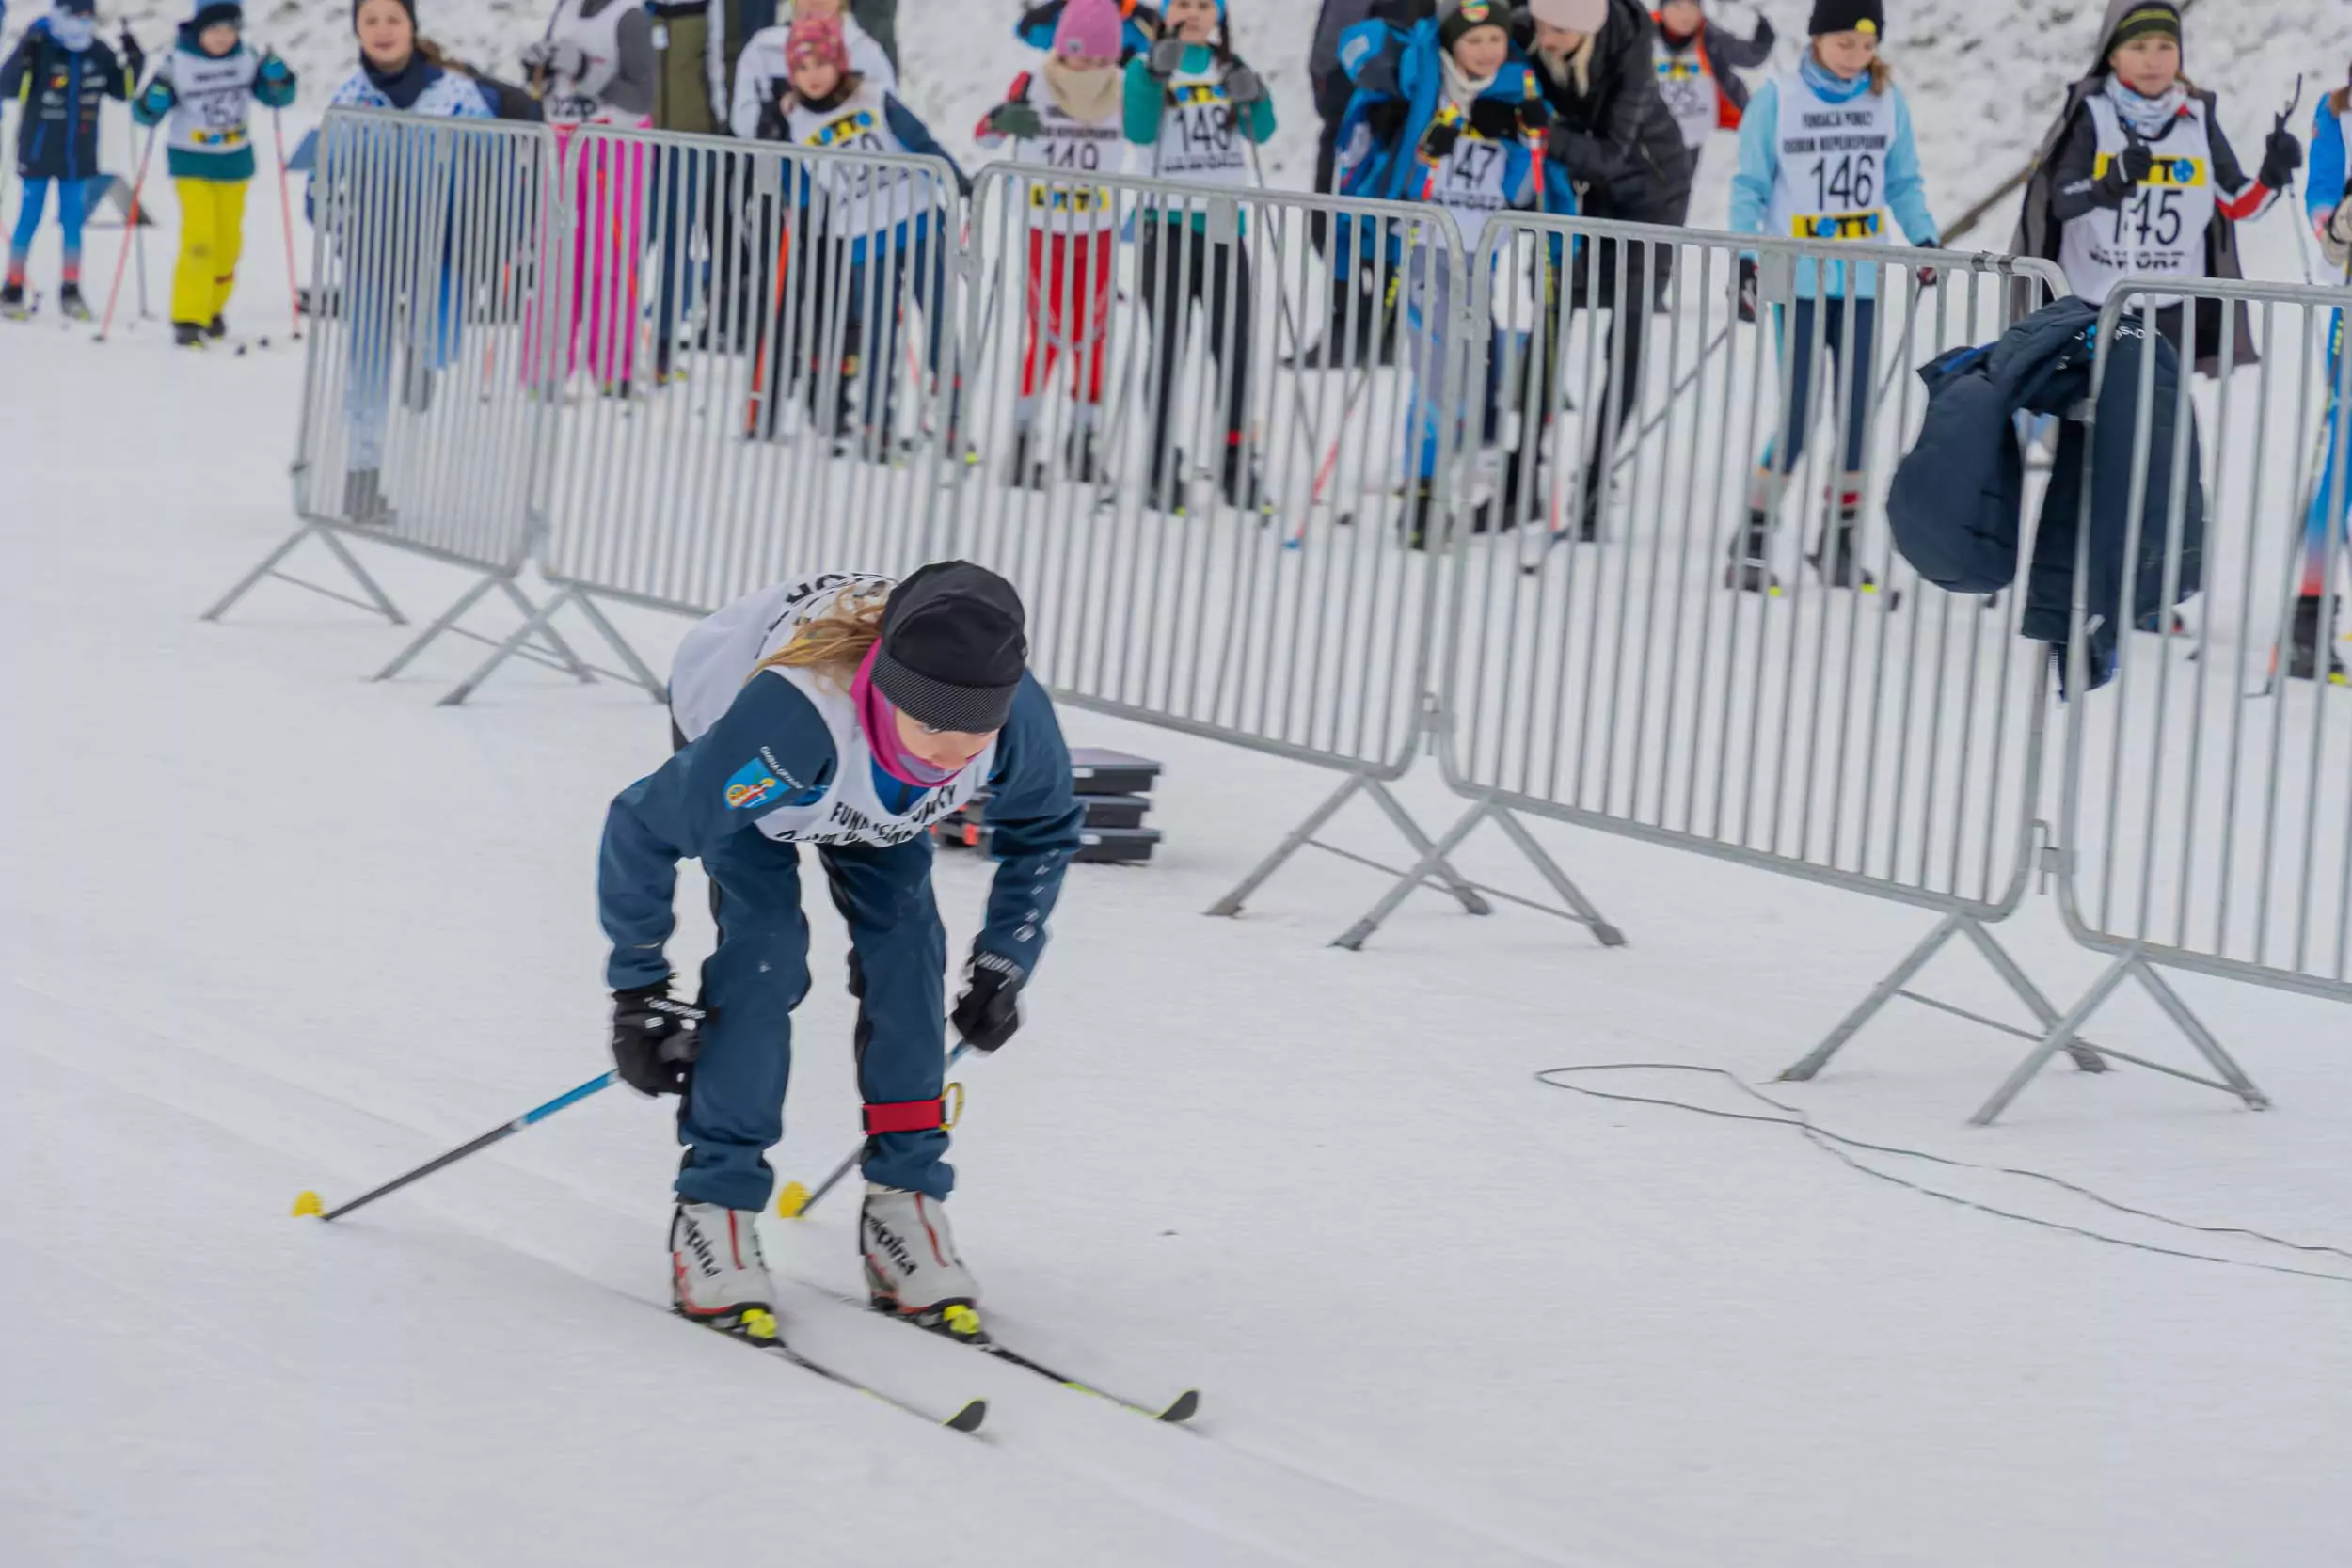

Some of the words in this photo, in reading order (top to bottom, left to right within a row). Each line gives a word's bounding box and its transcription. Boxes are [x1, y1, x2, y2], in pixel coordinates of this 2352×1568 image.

[1175, 105, 1230, 151] 148
[1810, 154, 1875, 212] 146
[1805, 213, 1879, 238] LOTTO
[2113, 189, 2184, 245] 145
